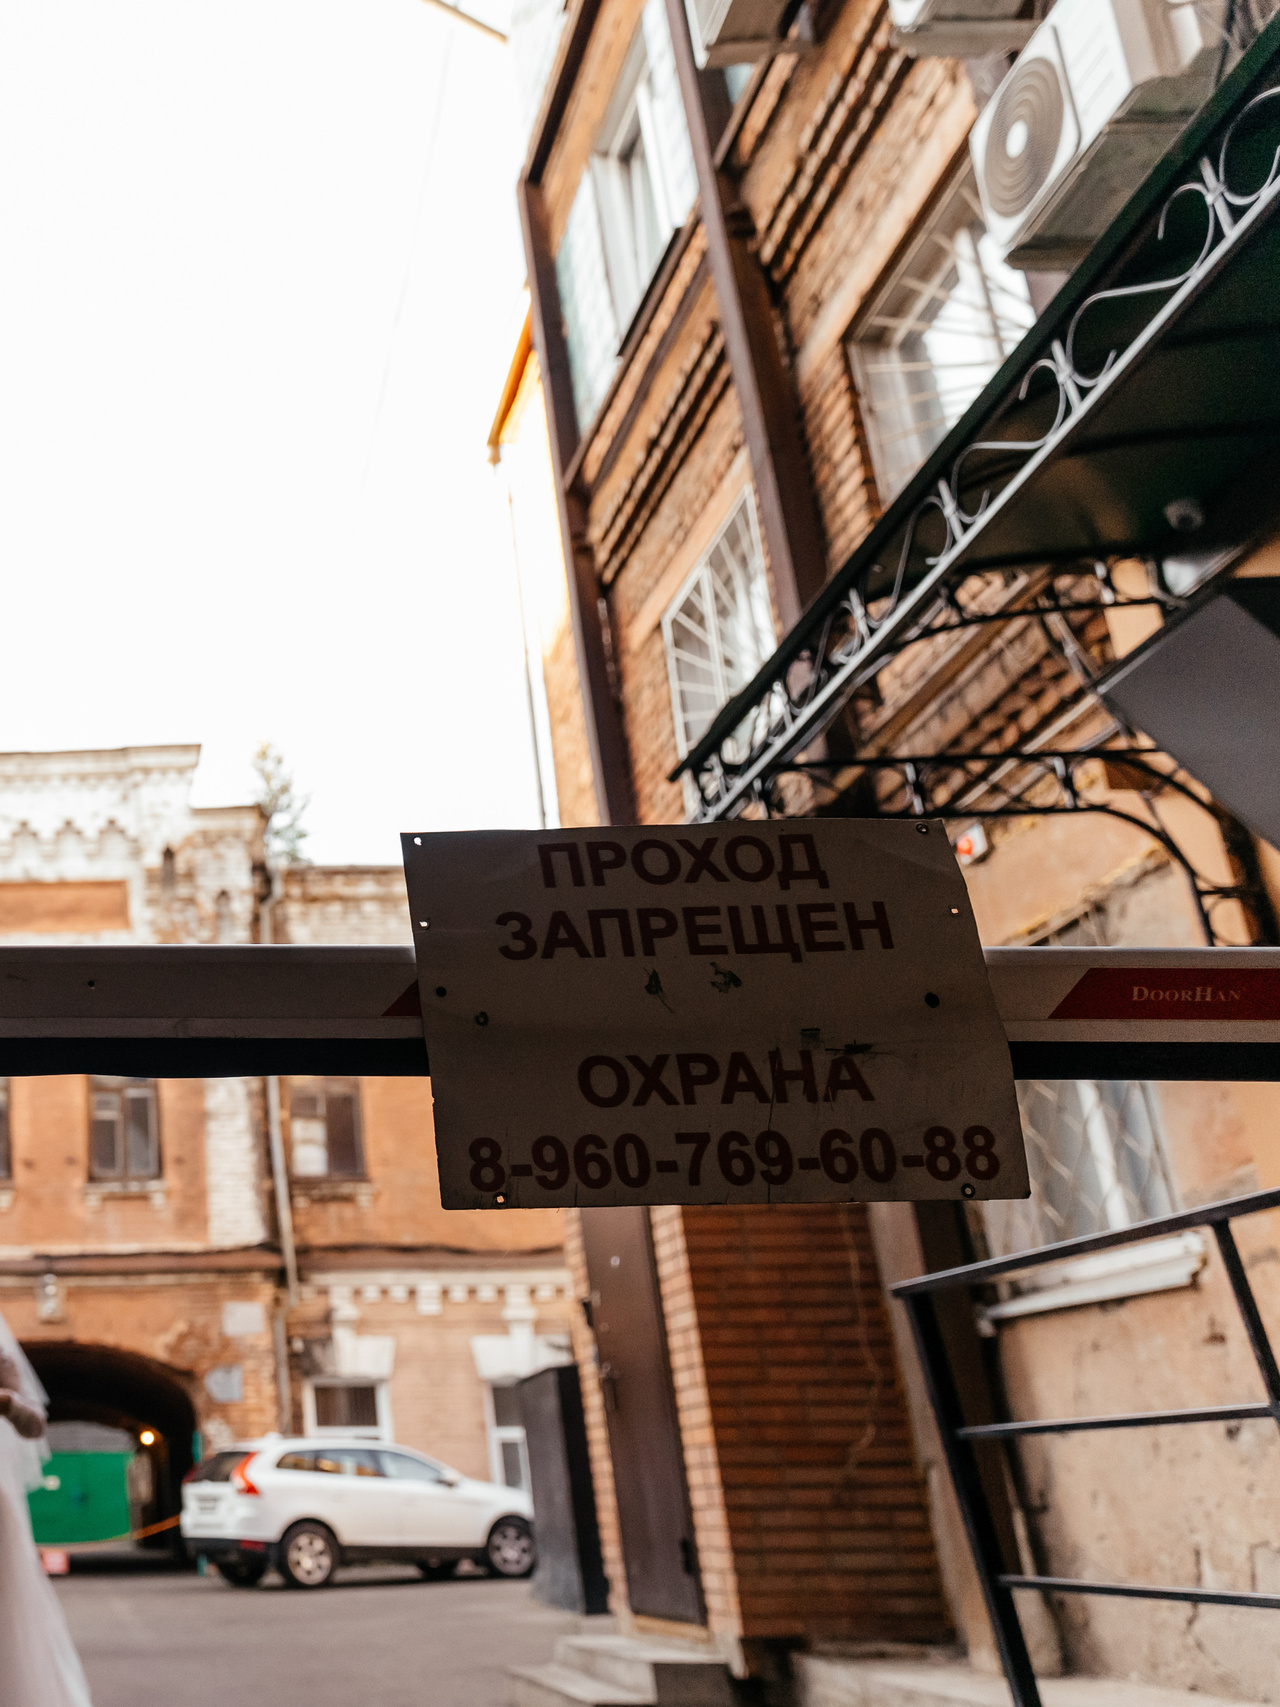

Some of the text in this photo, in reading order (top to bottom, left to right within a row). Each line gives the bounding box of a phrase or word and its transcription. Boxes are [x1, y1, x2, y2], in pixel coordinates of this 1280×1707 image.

[537, 833, 830, 890] ПРОХОД
[495, 901, 895, 963] ЗАПРЕЩЕН
[577, 1048, 875, 1108] ОХРАНА
[468, 1125, 1001, 1193] 8-960-769-60-88
